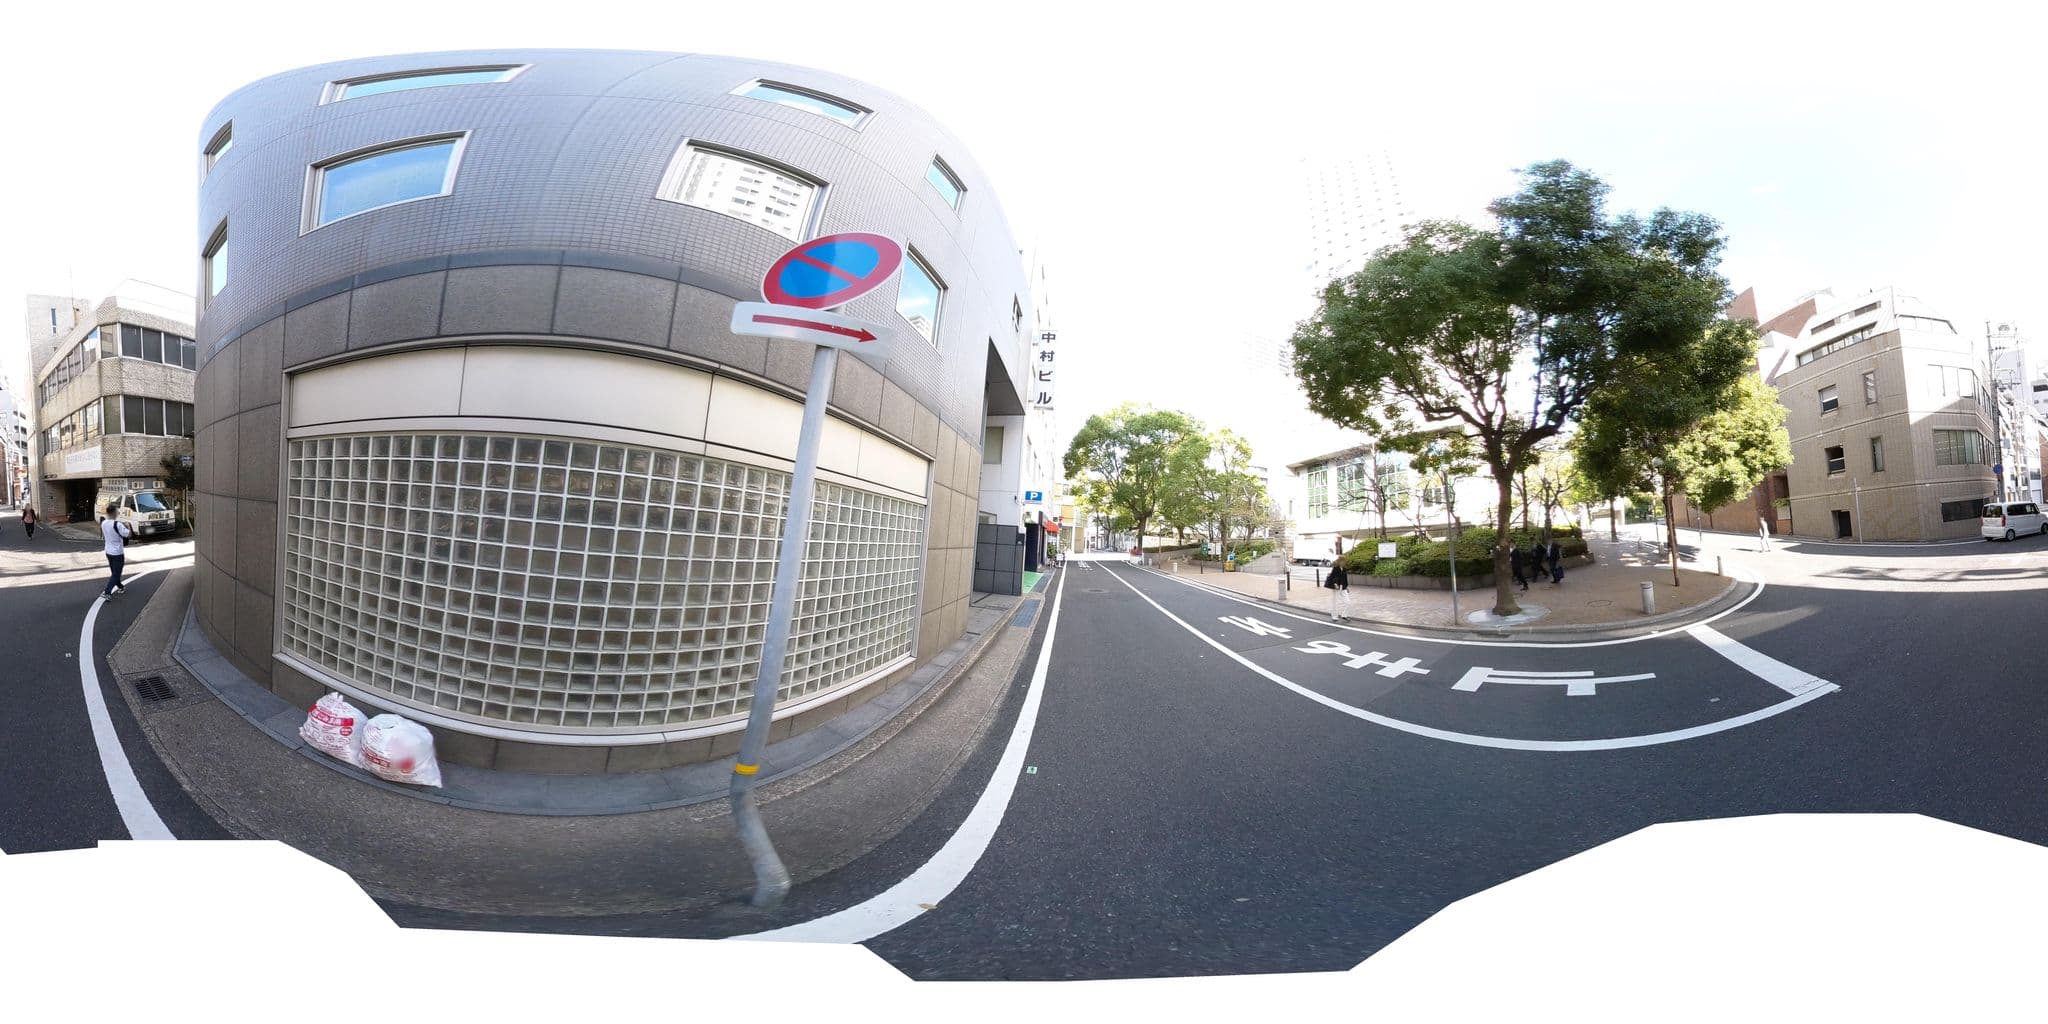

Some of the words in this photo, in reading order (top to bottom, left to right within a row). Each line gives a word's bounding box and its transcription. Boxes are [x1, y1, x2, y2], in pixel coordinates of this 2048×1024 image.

[1037, 332, 1056, 405] 中村ビル
[1030, 492, 1039, 501] P
[1217, 615, 1656, 696] 止まれ
